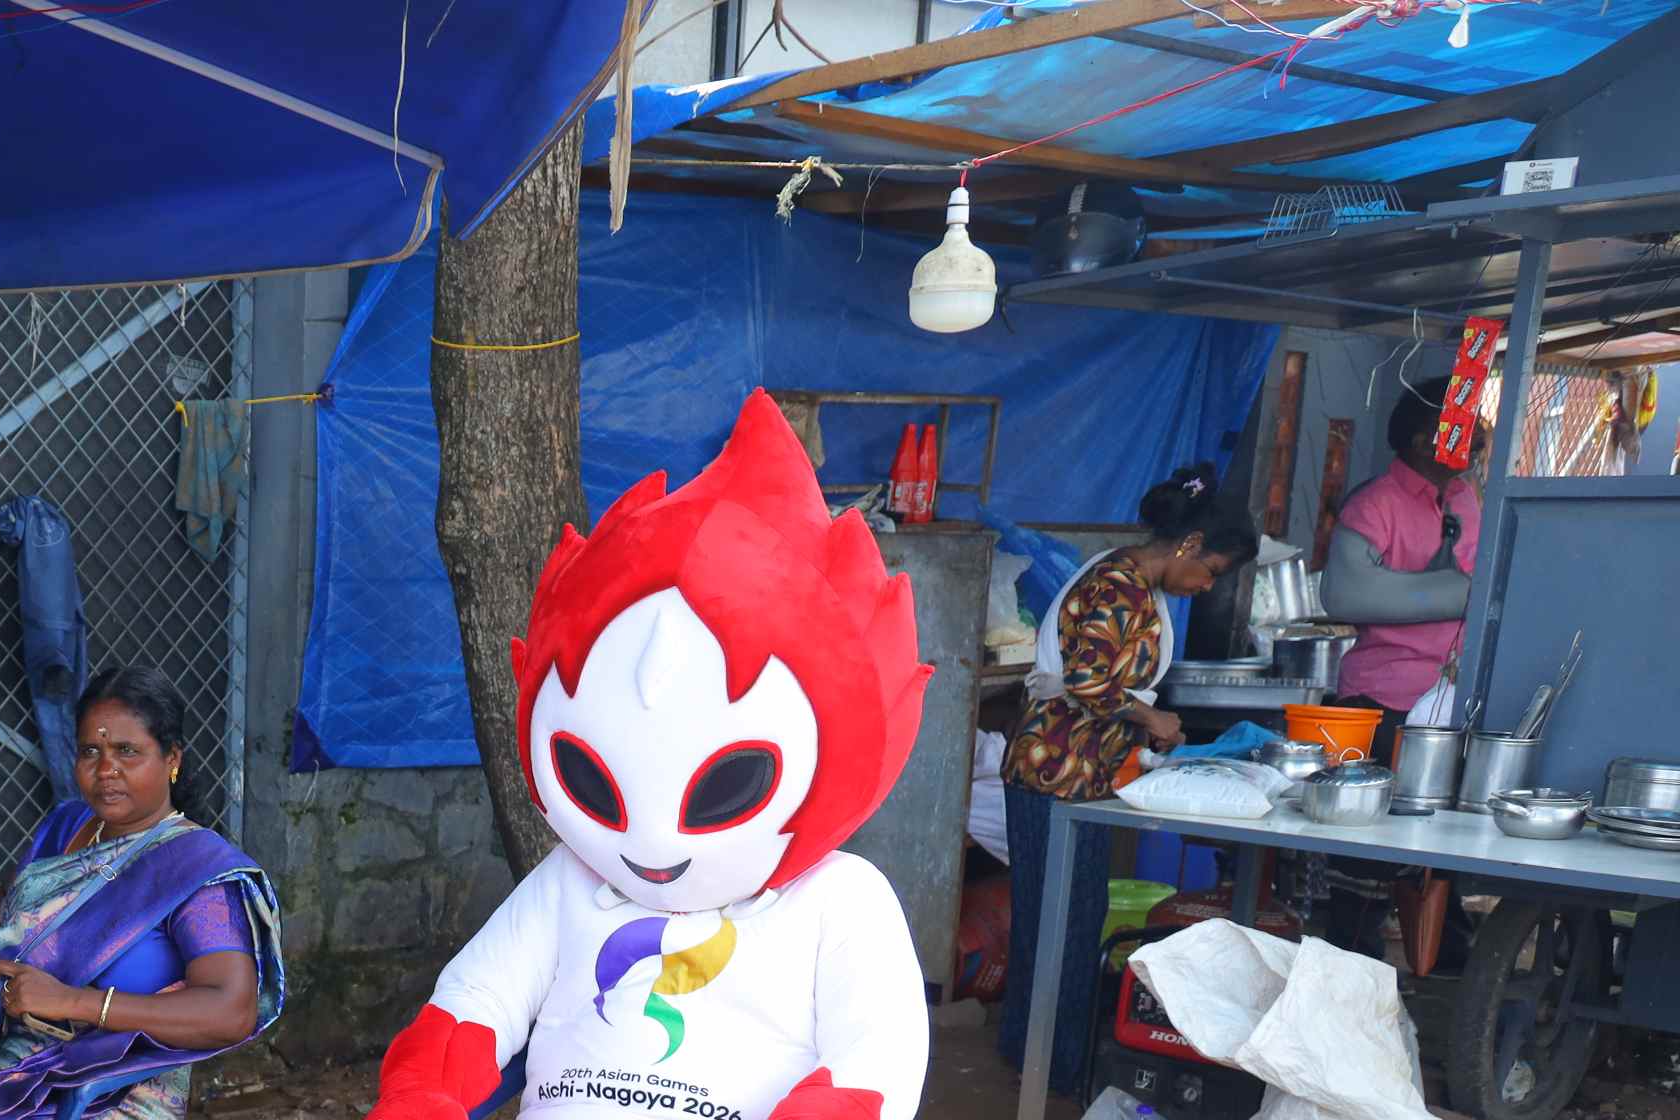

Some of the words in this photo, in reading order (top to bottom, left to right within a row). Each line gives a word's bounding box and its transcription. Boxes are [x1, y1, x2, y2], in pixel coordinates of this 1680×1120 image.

[1149, 1030, 1191, 1046] HON
[538, 1080, 676, 1110] Aichi-Nagoya
[561, 1067, 593, 1079] 20th
[596, 1068, 641, 1083] Asian
[646, 1074, 710, 1097] Games
